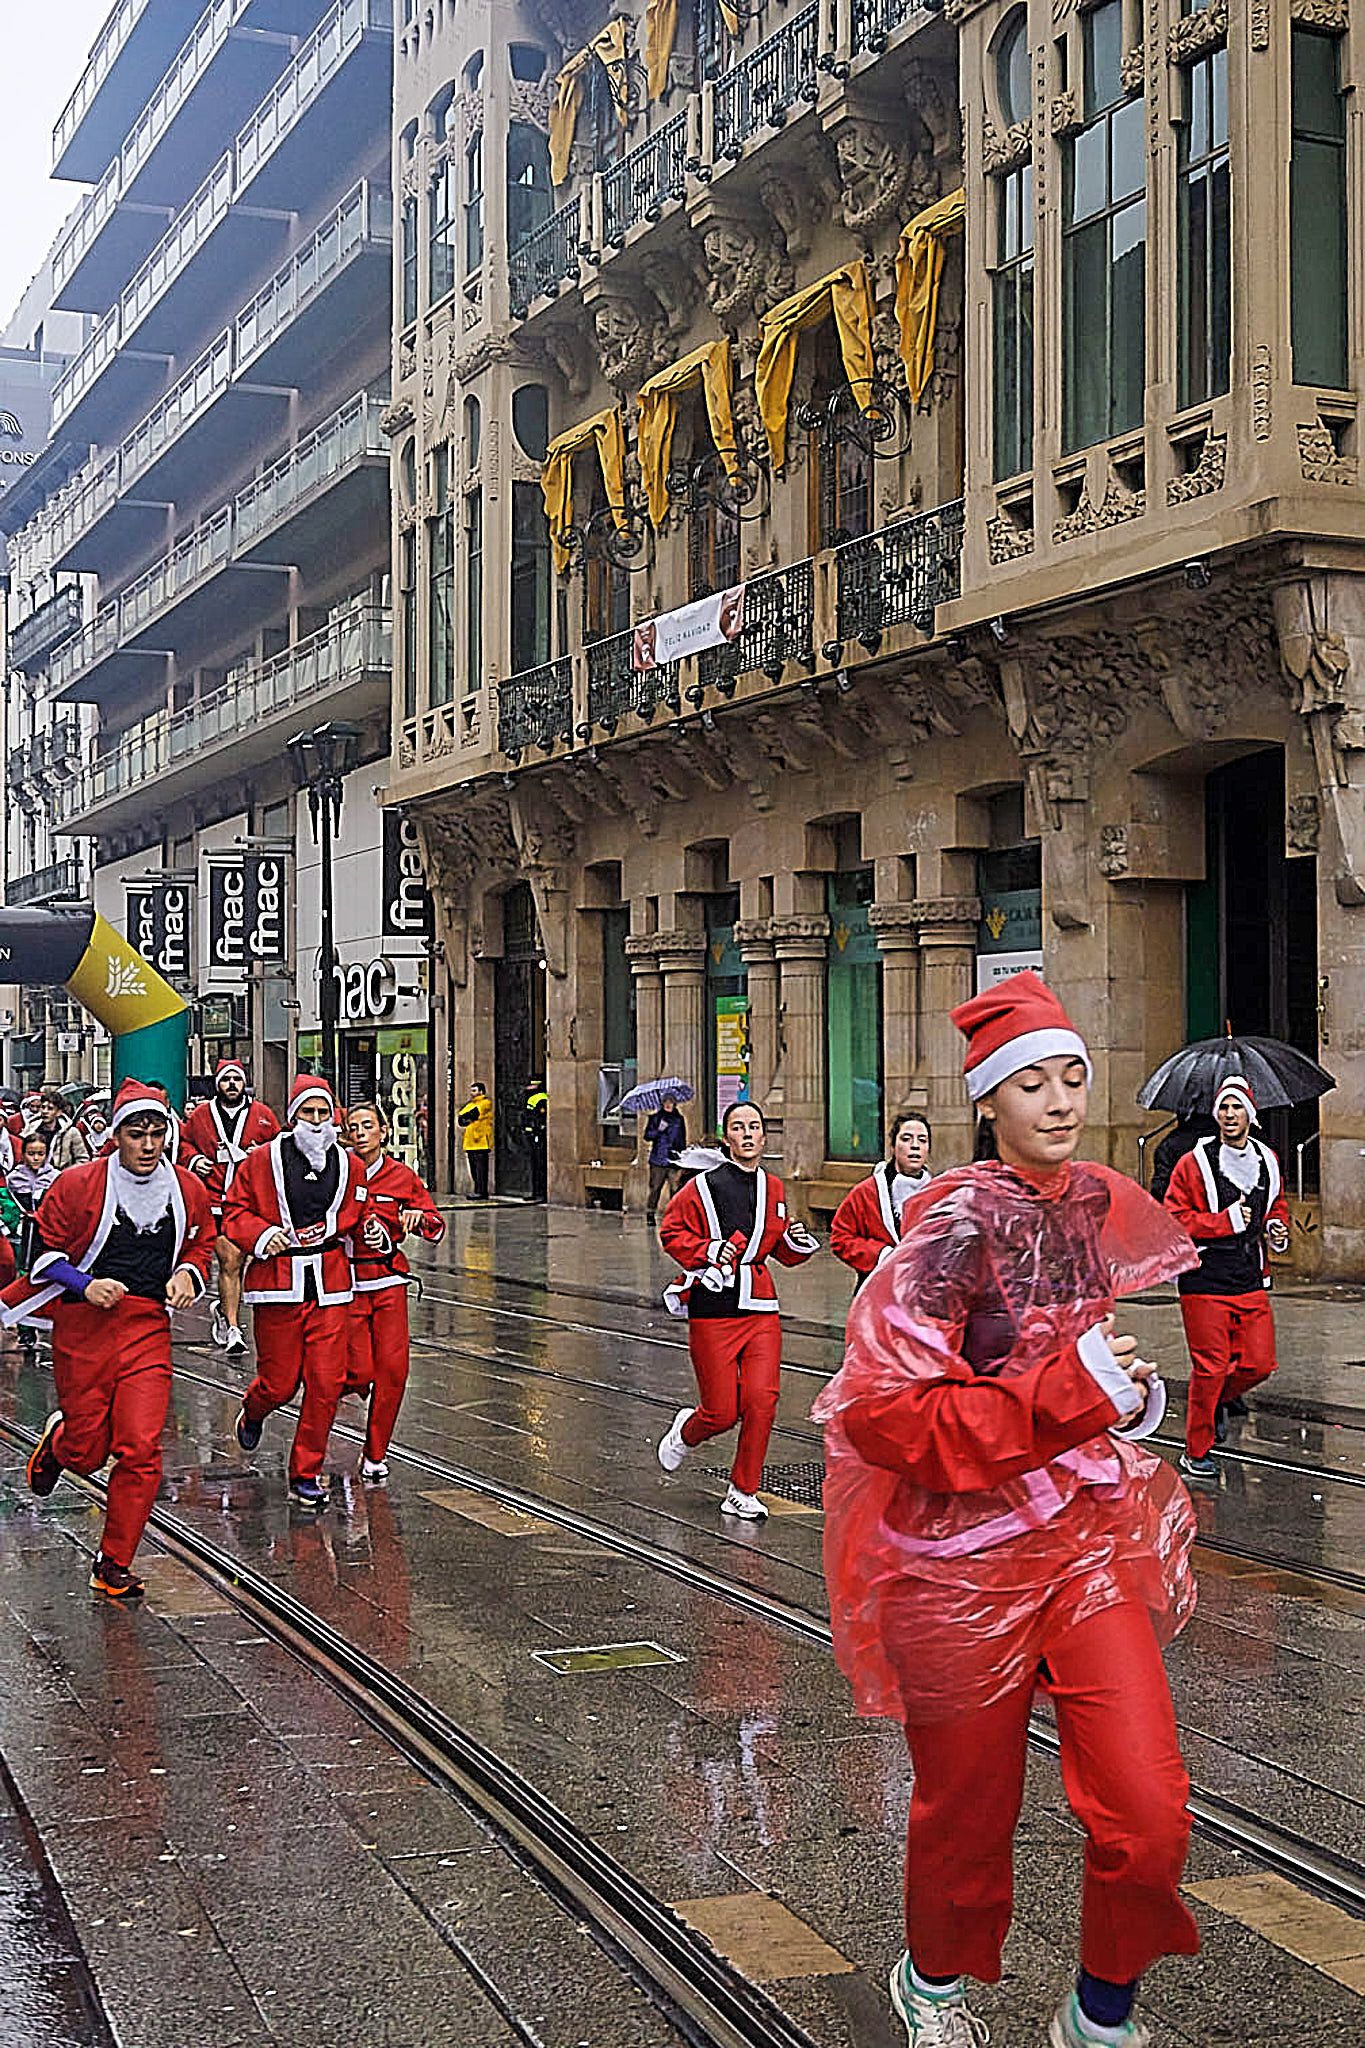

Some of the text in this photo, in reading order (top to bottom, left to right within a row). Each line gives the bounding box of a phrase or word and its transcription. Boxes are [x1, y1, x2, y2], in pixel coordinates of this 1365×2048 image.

[0, 451, 41, 466] ONS
[216, 871, 244, 962] fnac
[249, 861, 279, 956] fnac
[390, 819, 424, 930] fnac
[139, 897, 154, 963] nac
[158, 889, 184, 973] fnac
